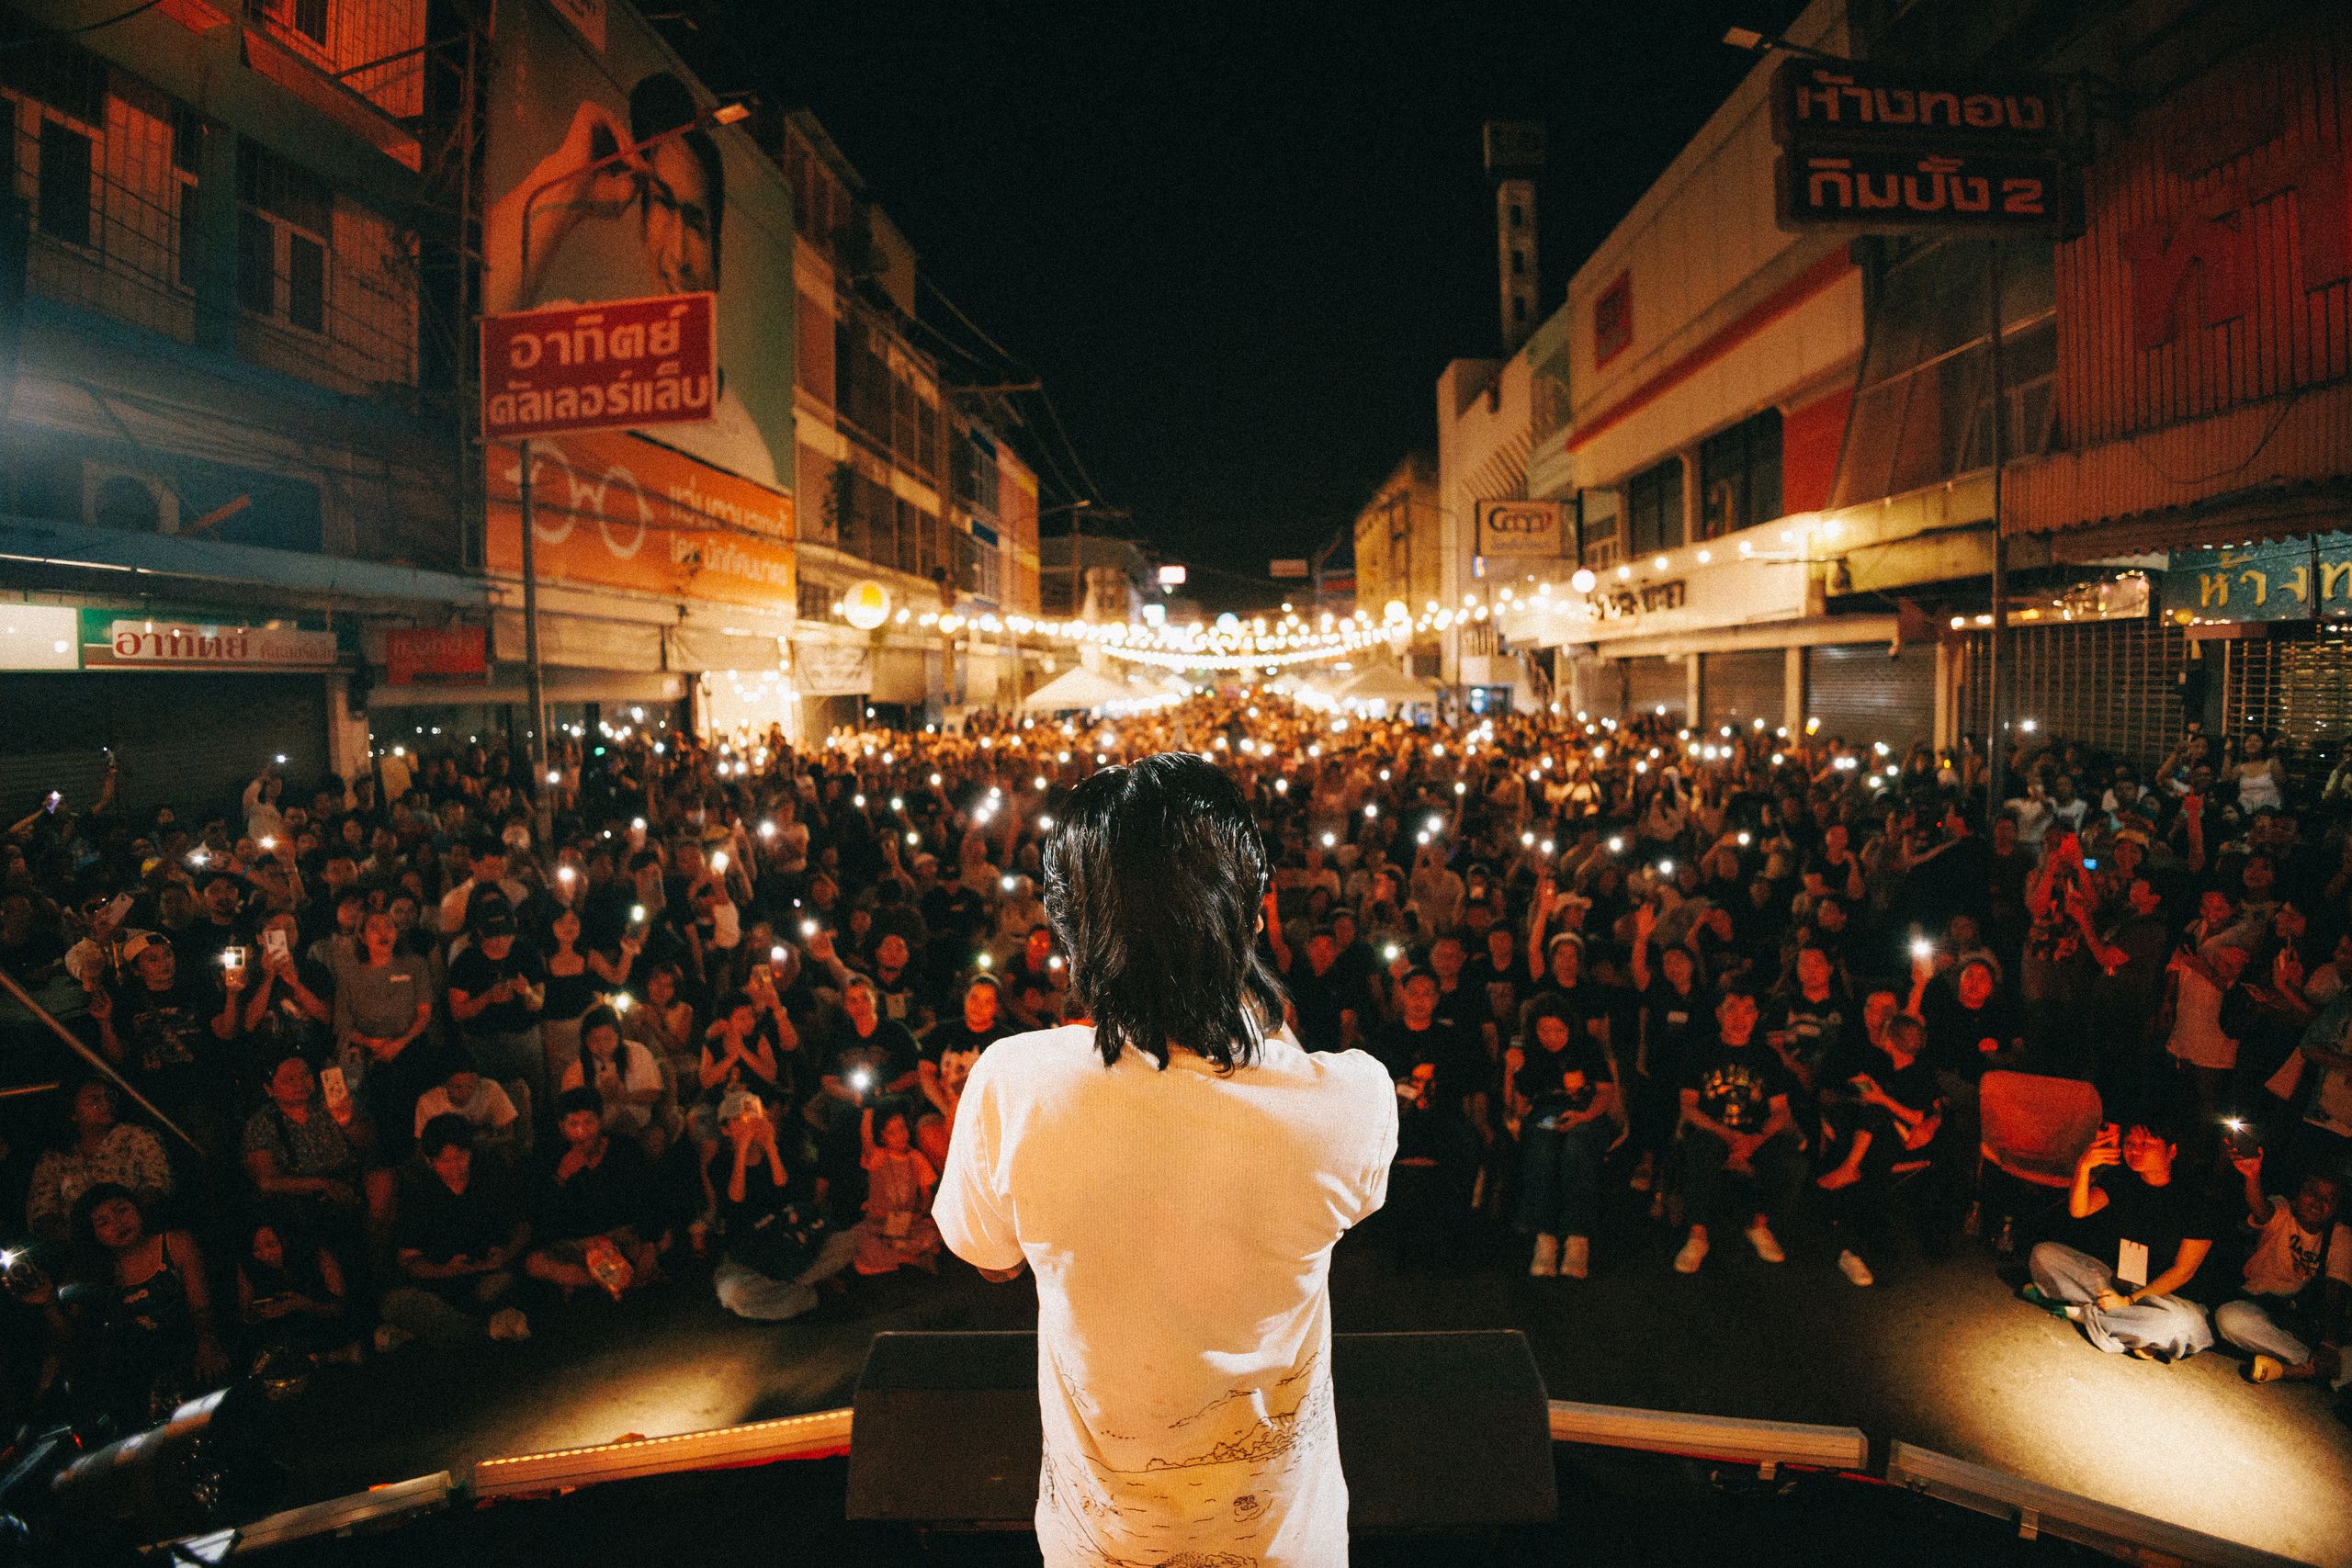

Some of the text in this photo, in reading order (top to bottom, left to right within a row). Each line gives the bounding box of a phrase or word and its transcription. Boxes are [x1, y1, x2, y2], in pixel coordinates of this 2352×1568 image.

[1795, 69, 2046, 130] ห้างทอง
[1807, 154, 2045, 215] กิมปั้ง 2
[510, 304, 687, 370] อาทิตย์
